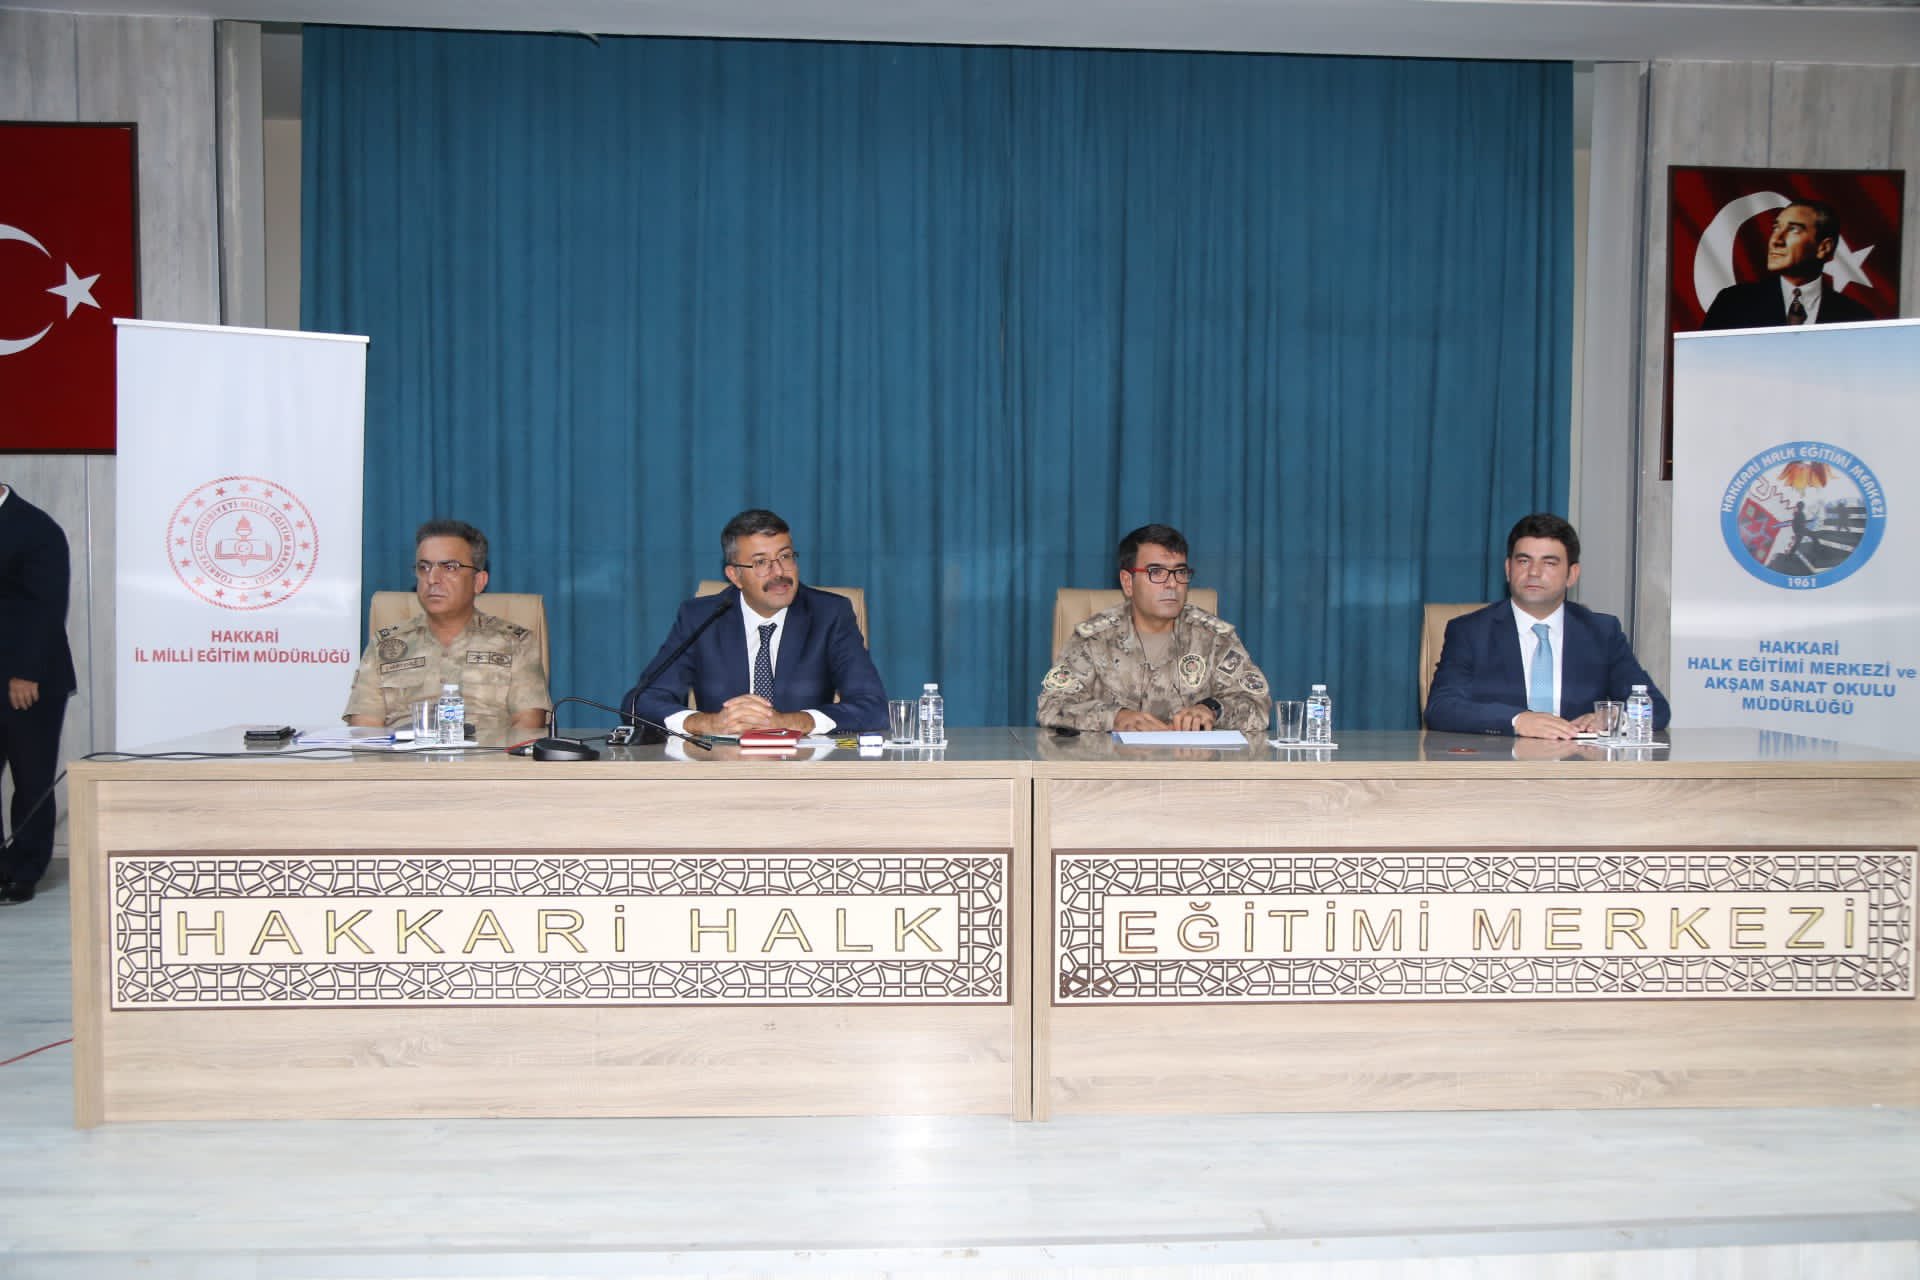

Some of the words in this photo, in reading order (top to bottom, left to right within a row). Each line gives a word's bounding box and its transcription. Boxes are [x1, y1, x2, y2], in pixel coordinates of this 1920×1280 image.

[1788, 577, 1817, 588] 1961
[211, 628, 279, 643] HAKKARİ
[135, 647, 148, 663] İL
[152, 647, 193, 663] MİLLİ
[198, 647, 249, 663] EĞİTİM
[254, 648, 350, 664] MÜDÜRLÜĞÜ
[1759, 640, 1839, 656] HAKKARİ
[1687, 657, 1733, 672] HALK
[1738, 657, 1804, 675] EĞİTİMİ
[1810, 661, 1891, 678] MERKEZİ
[1896, 667, 1918, 679] ve
[1704, 677, 1765, 694] AKŞAM
[1769, 679, 1828, 694] SANAT
[1833, 682, 1896, 698] OKULU
[1742, 696, 1855, 716] MÜDÜRLÜĞÜ
[689, 907, 943, 953] HALK
[1118, 900, 1429, 954] EĞİTİMİ
[1472, 897, 1855, 951] MERKEZİ
